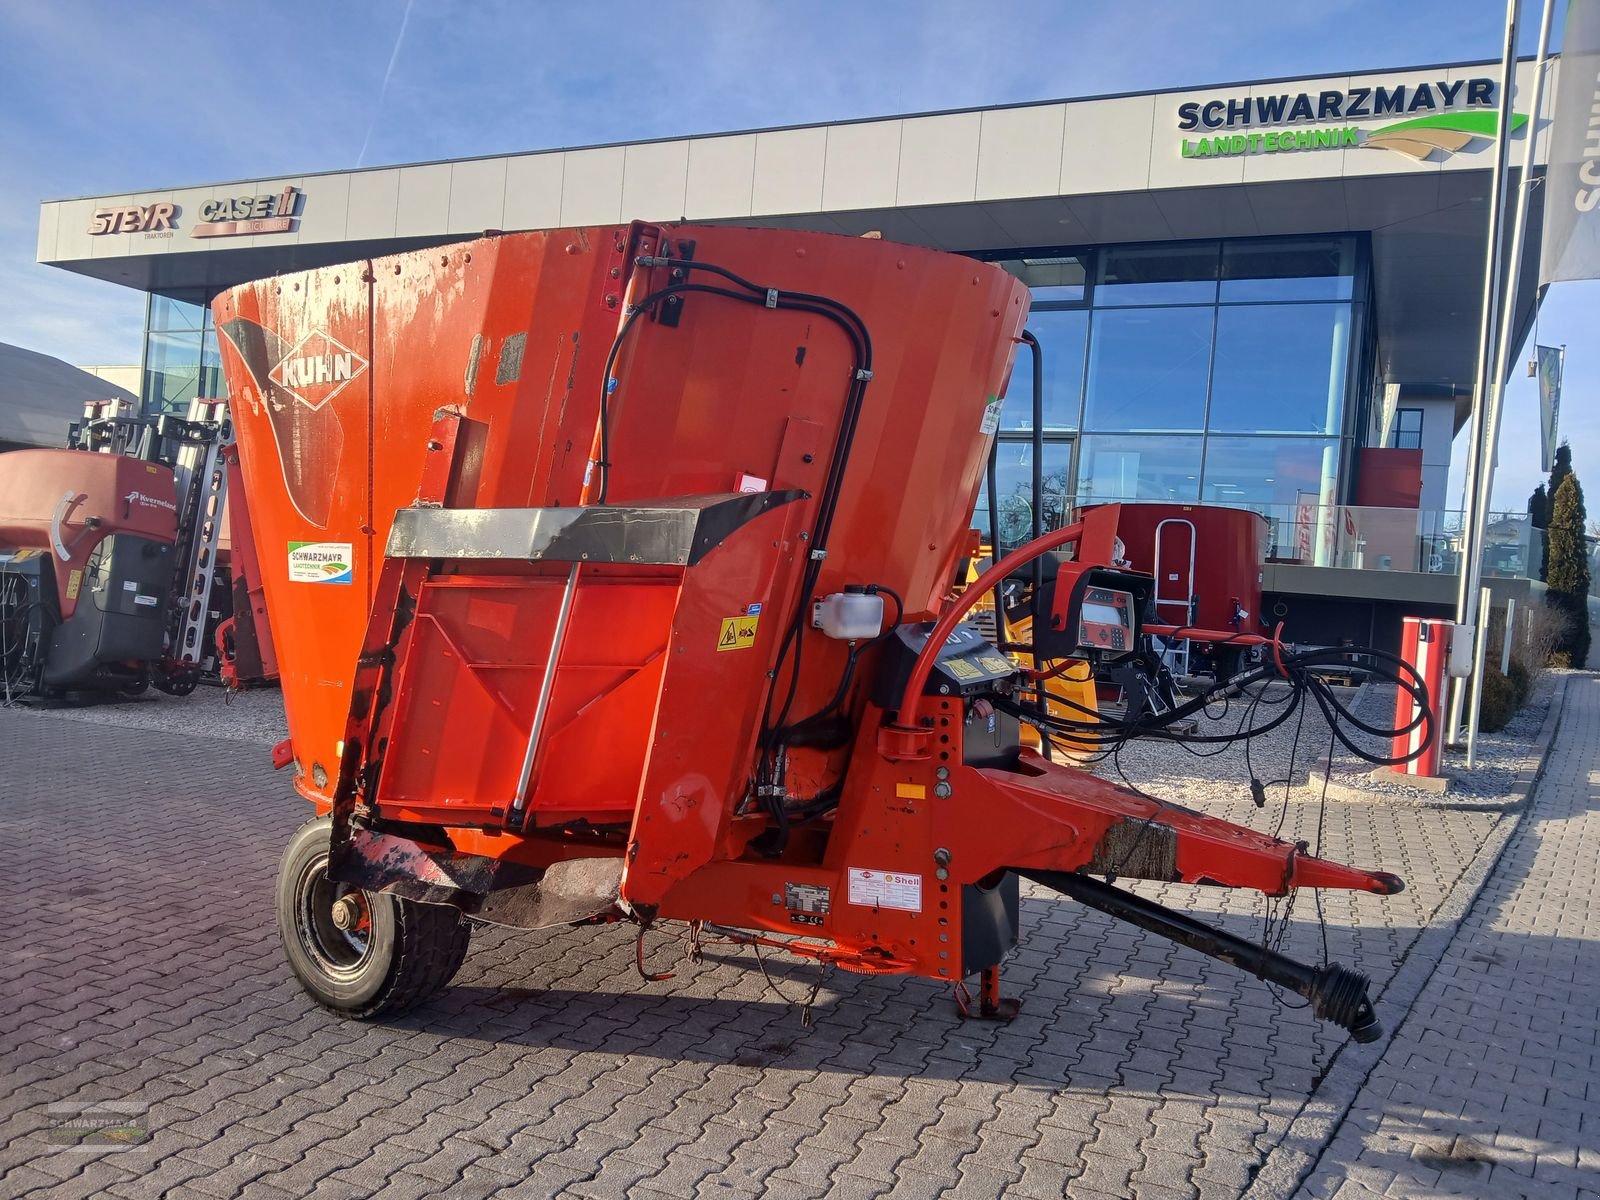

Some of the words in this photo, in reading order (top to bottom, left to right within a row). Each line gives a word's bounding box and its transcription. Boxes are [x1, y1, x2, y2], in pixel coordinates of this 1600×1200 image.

[1178, 78, 1495, 131] SCHWARZMAYR
[1182, 127, 1359, 158] LANDTECHNIK
[87, 203, 177, 235] STEYR
[199, 194, 271, 222] CASE
[144, 231, 174, 240] TRAKTOREN
[282, 352, 352, 388] KUHN
[140, 494, 176, 511] Kverneland
[292, 552, 343, 562] SCHWARZMAYR
[894, 876, 919, 886] Shell
